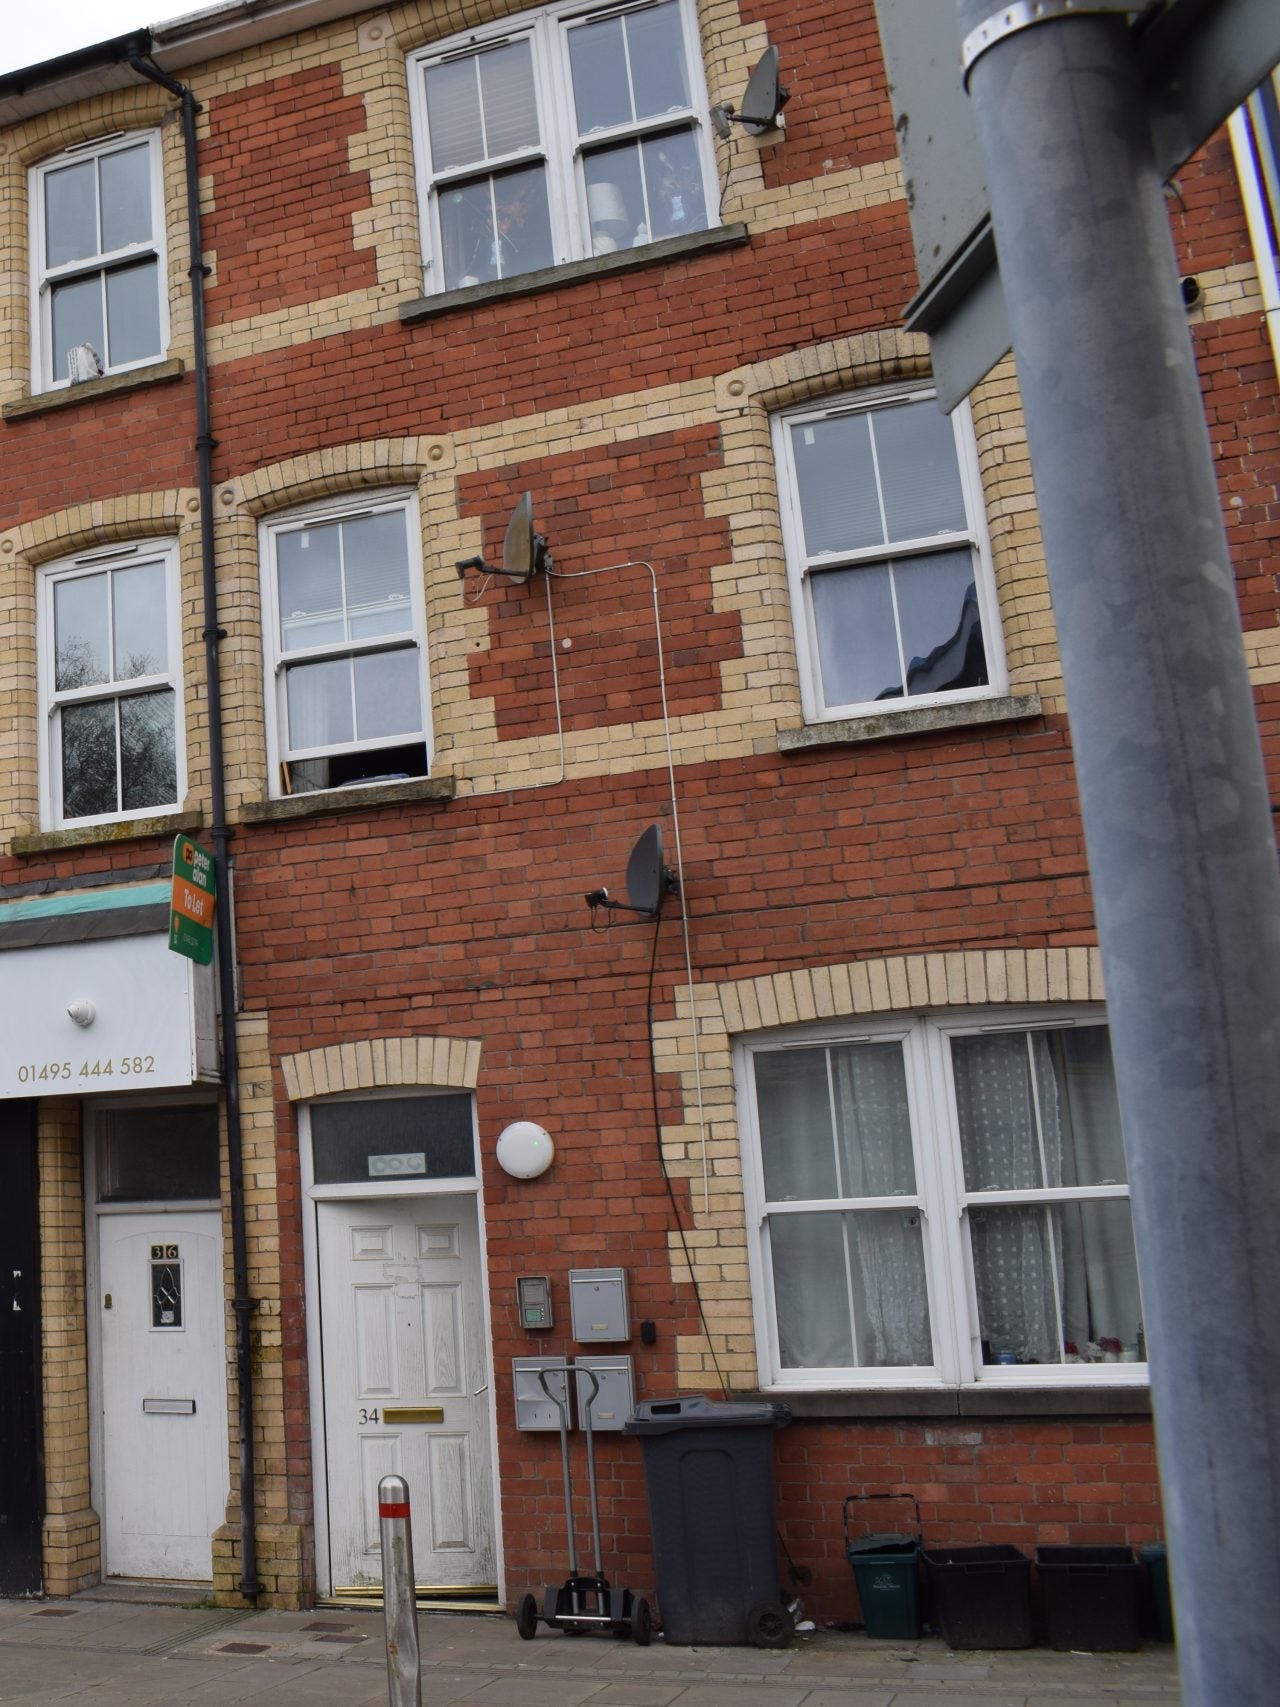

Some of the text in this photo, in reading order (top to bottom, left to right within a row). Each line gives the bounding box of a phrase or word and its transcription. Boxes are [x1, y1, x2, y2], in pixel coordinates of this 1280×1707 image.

[193, 850, 210, 872] peter
[192, 867, 207, 888] alan
[184, 888, 204, 918] To Let
[18, 1055, 155, 1082] 01495 444 582
[153, 1246, 177, 1258] 36
[358, 1408, 380, 1425] 34
